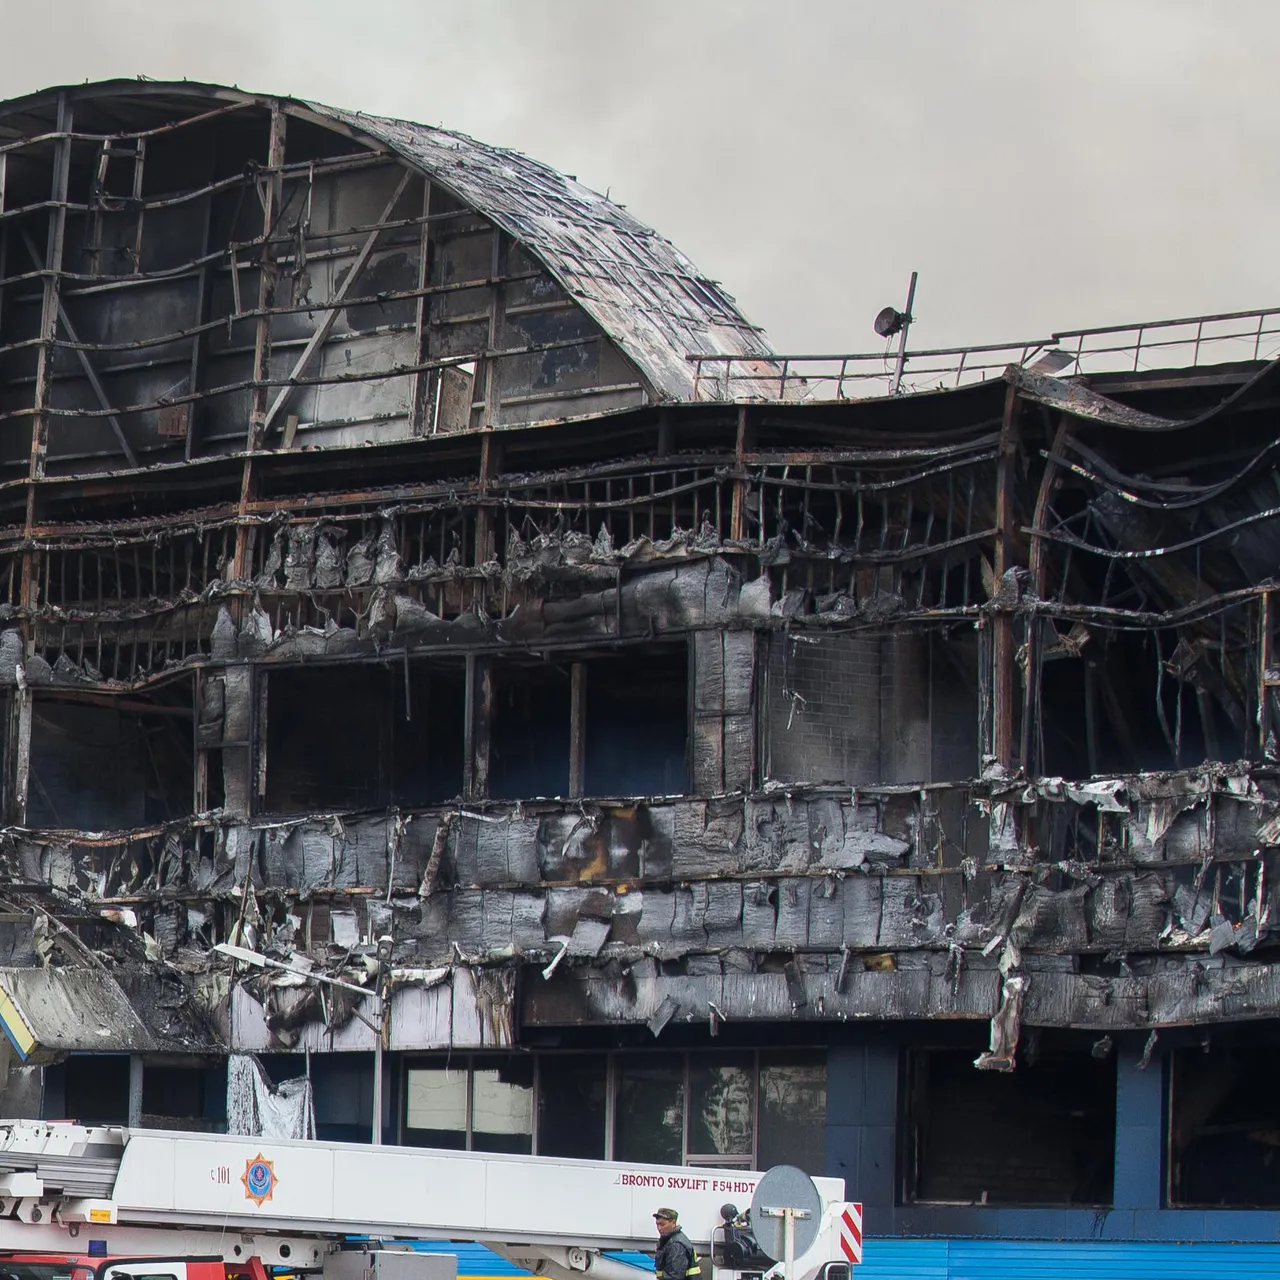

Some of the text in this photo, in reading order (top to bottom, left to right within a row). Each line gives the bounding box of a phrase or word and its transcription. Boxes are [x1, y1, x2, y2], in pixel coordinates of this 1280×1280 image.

[216, 1166, 231, 1184] 101
[621, 1174, 665, 1187] BRONTO
[667, 1177, 708, 1190] SKYLIFT
